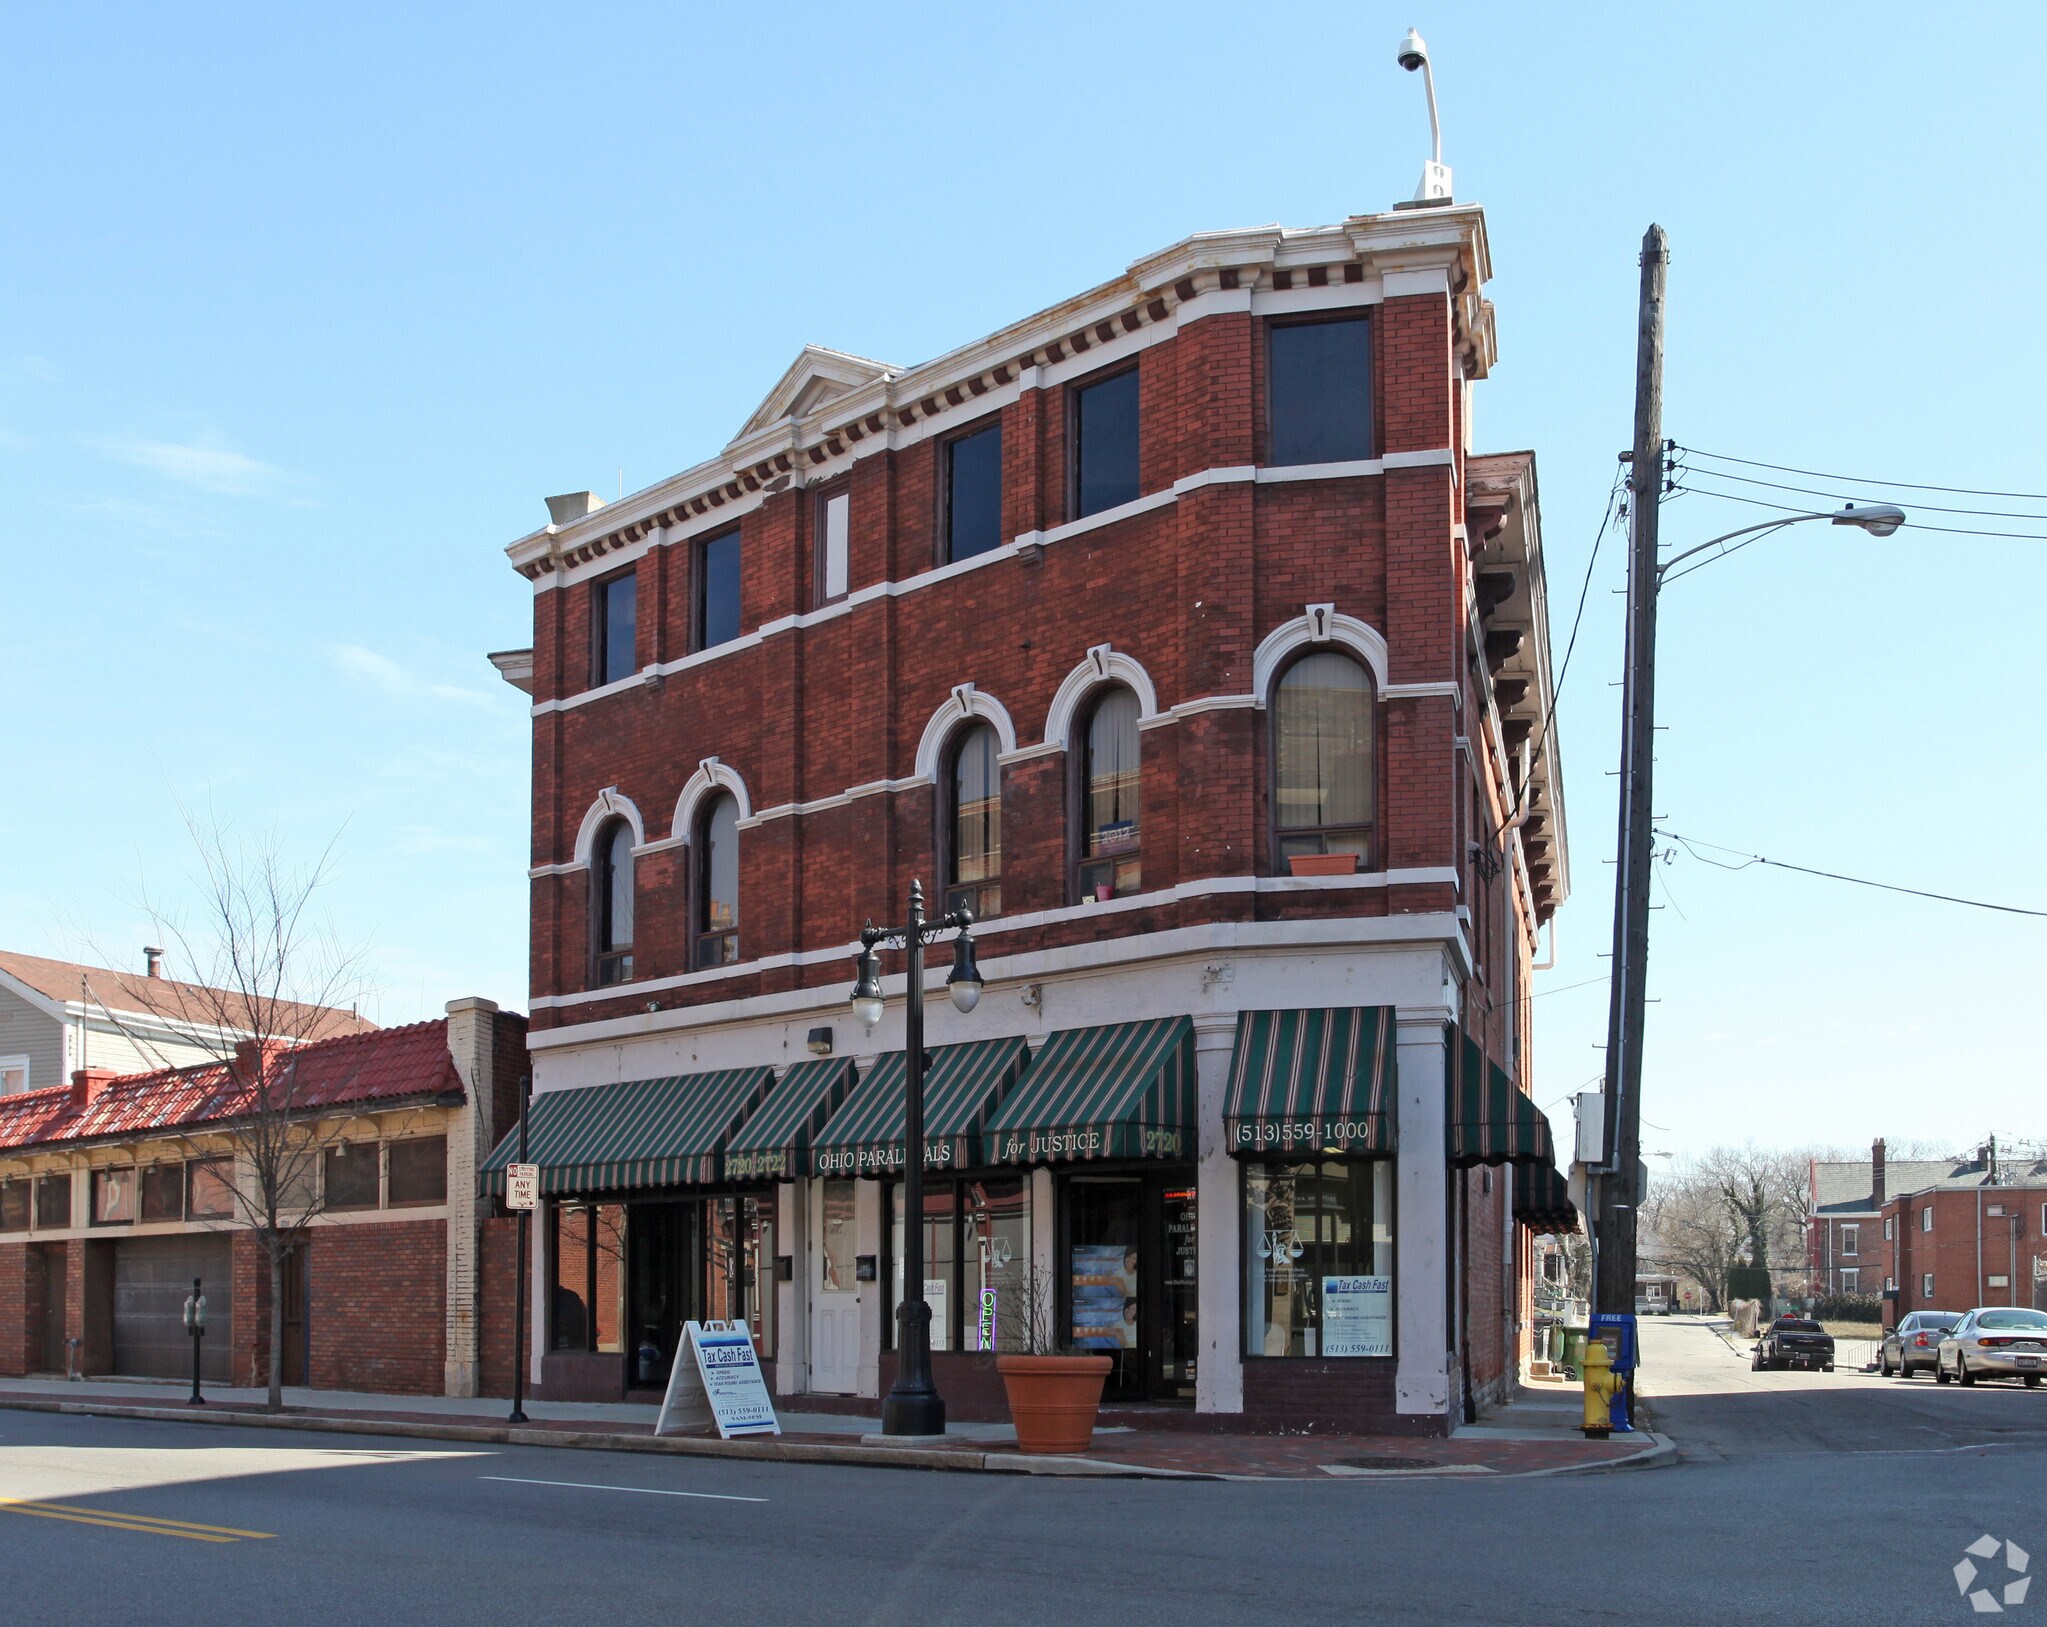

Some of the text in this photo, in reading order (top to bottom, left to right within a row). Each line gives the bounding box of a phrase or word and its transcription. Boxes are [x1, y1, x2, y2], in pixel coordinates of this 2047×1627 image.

[1236, 1122, 1368, 1143] (513)559-1000
[1002, 1132, 1099, 1158] for JUSTICE
[1146, 1131, 1181, 1151] 2720
[819, 1145, 950, 1170] OHIO PARALALS
[508, 1166, 518, 1177] NO
[515, 1191, 531, 1199] TIME
[1338, 1280, 1389, 1290] Tax Cash Fast
[981, 1292, 994, 1350] OPEN
[1601, 1314, 1622, 1322] FREE
[702, 1347, 754, 1363] Tax Cash Fast
[1325, 1344, 1390, 1354] (513) 559-0111
[718, 1406, 769, 1416] (513) 559-0111
